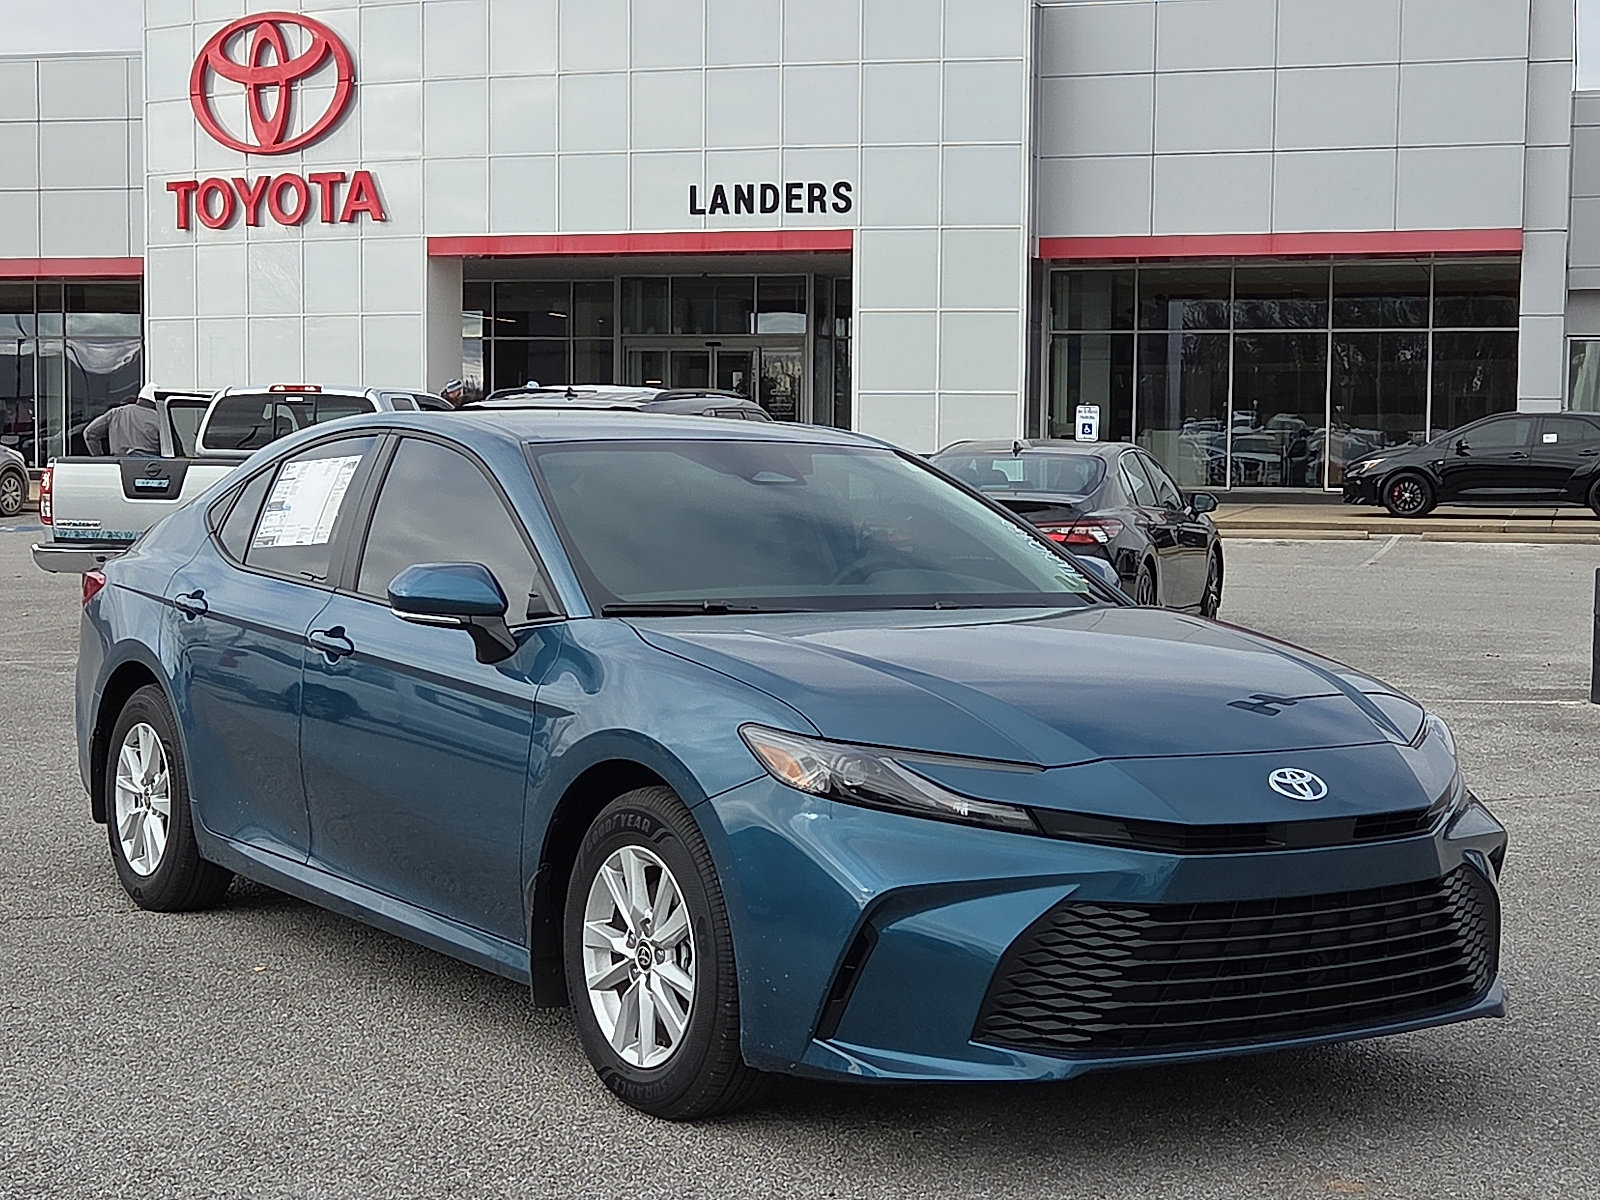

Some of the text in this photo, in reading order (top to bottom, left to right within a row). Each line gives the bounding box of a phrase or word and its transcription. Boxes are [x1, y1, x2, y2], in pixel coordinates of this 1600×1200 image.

[166, 170, 387, 230] TOYOTA
[689, 181, 853, 215] LANDERS
[585, 813, 651, 853] GOODYEAR
